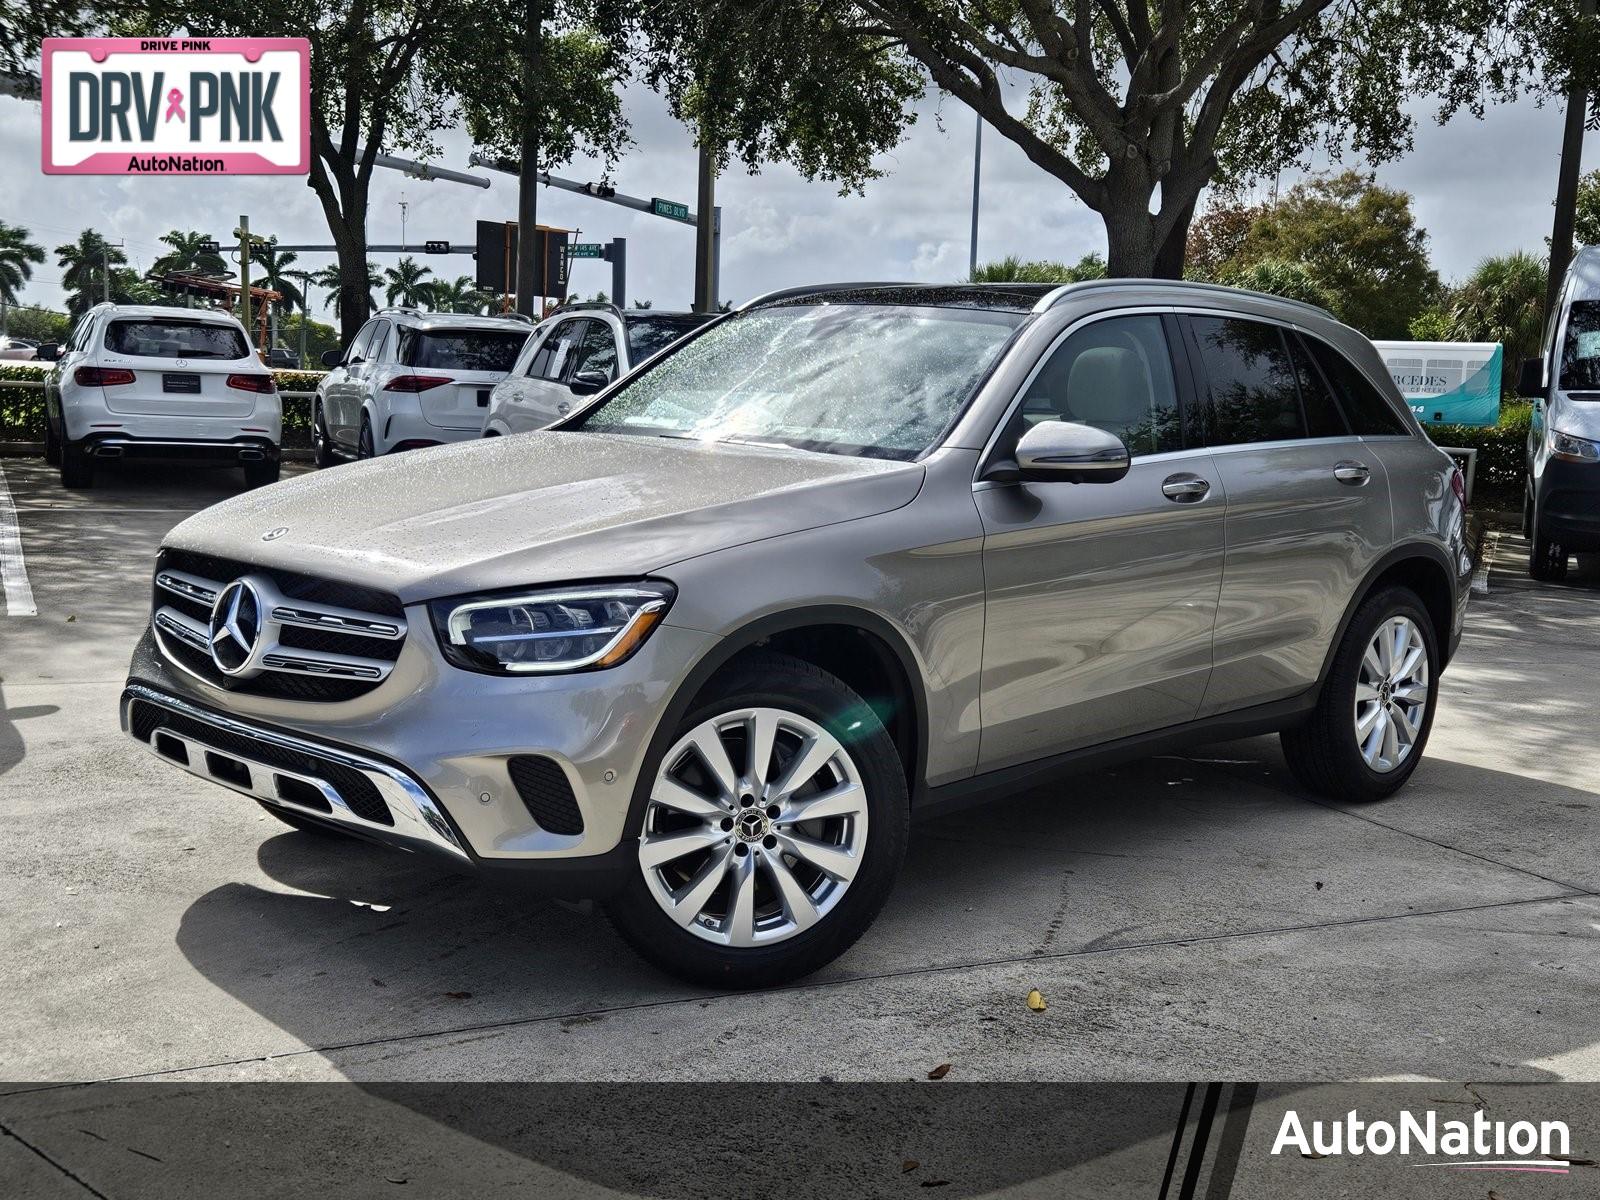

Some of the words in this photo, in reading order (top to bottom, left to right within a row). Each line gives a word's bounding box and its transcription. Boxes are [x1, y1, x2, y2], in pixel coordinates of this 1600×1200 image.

[658, 202, 673, 214] PINES
[673, 206, 686, 217] BLVD
[1393, 375, 1447, 386] RCEDES
